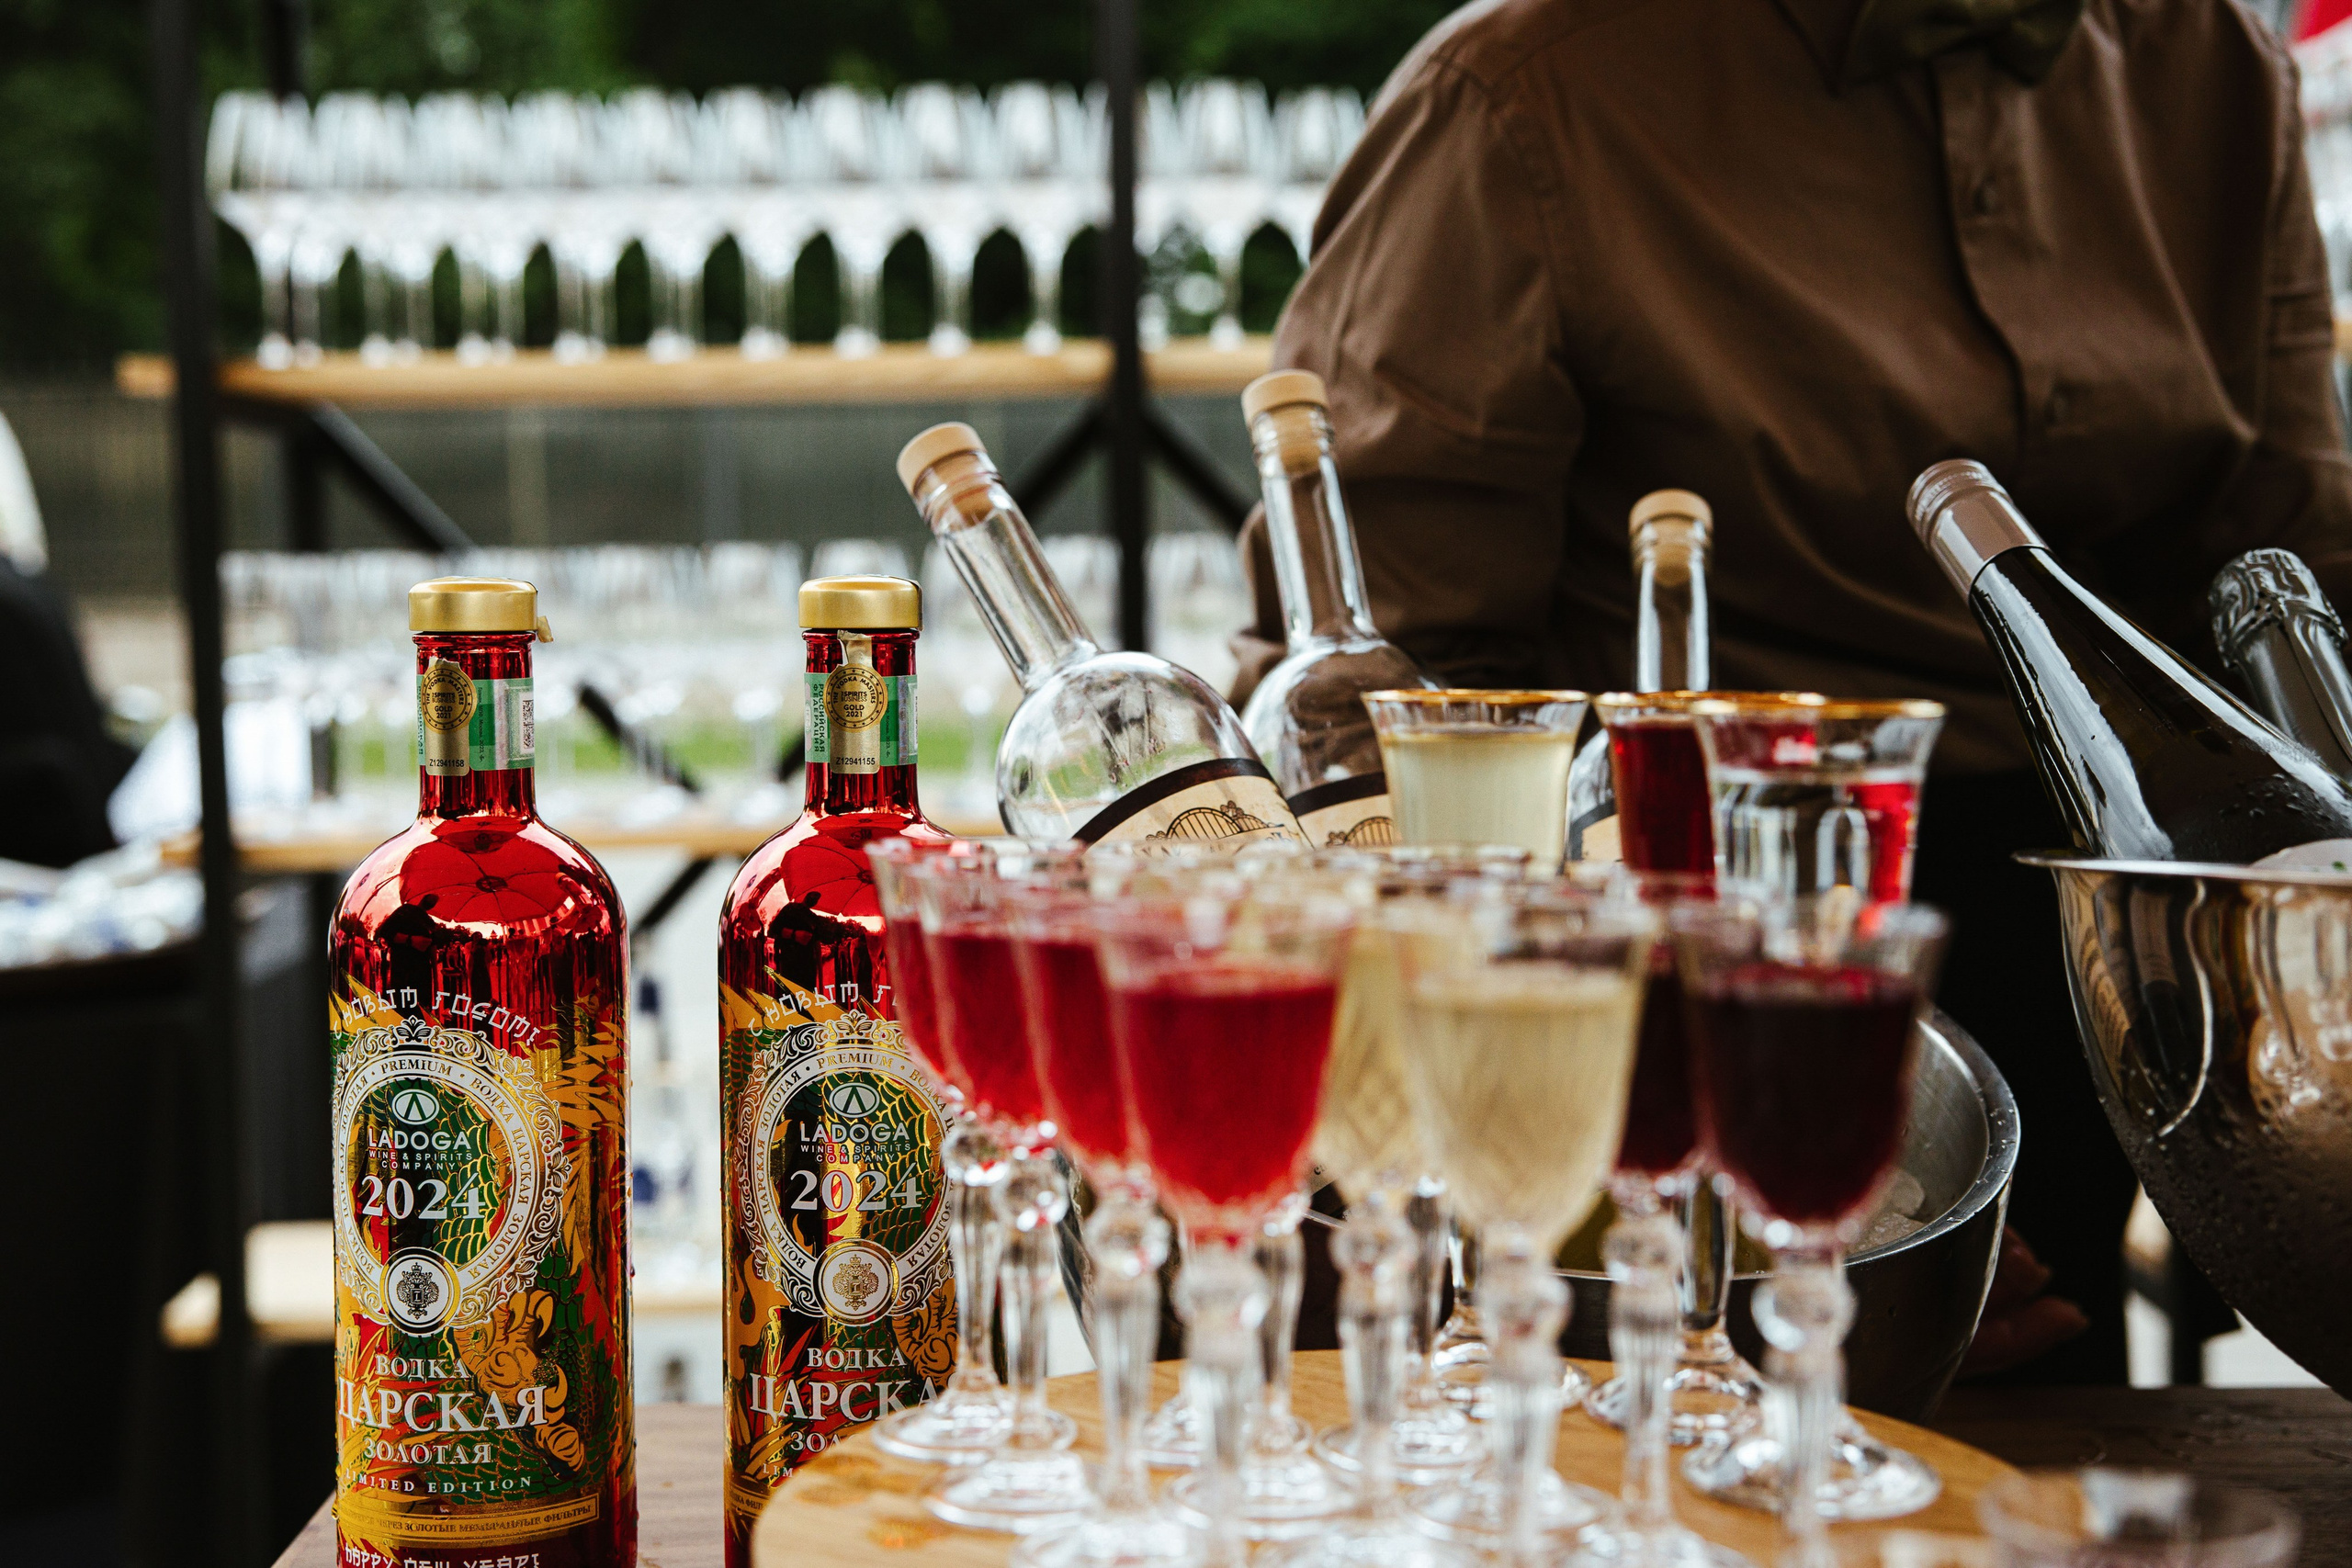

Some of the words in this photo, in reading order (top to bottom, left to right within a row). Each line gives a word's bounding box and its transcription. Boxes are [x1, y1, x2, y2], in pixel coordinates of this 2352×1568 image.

[836, 676, 857, 689] VODKA
[860, 678, 876, 704] MASTERS
[818, 683, 826, 752] РОССИЙСКАЯ
[429, 758, 465, 768] Z12941158
[836, 757, 876, 766] Z12941155
[380, 1060, 454, 1077] PREMIUM
[817, 1053, 894, 1069] PREMIUM
[469, 1077, 514, 1123] ВОДКА
[760, 1070, 802, 1132] ЗОЛОТАЯ
[368, 1127, 471, 1150] LADOGA
[799, 1122, 910, 1143] LADOGA
[368, 1150, 397, 1160] WINE
[402, 1152, 409, 1161] &
[415, 1152, 473, 1161] SPIRITS
[800, 1144, 834, 1154] WINE
[841, 1145, 848, 1154] &
[854, 1143, 910, 1154] SPIRITS
[817, 1153, 895, 1164] COMPANY
[381, 1160, 457, 1171] COMPANY
[512, 1127, 532, 1204] ЦАРСКАЯ
[756, 1140, 772, 1215] ЦАРСКАЯ
[361, 1172, 487, 1220] 2024
[790, 1162, 922, 1213] 2024
[468, 1213, 524, 1280] ЗОЛОТАЯ
[770, 1221, 807, 1269] ВОДКА
[375, 1354, 471, 1382] ВОДКА
[807, 1348, 908, 1372] ВОДКА
[338, 1377, 548, 1433] ЦАРСКАЯ
[750, 1373, 939, 1424] ЦАРСКА
[363, 1438, 492, 1465] ЗОЛОТАЯ
[345, 1468, 414, 1492] LIMITED
[428, 1476, 532, 1494] EDITION
[404, 1522, 457, 1532] ЗОЛОТЫЕ
[543, 1505, 592, 1522] ФИЛЬТРЫ
